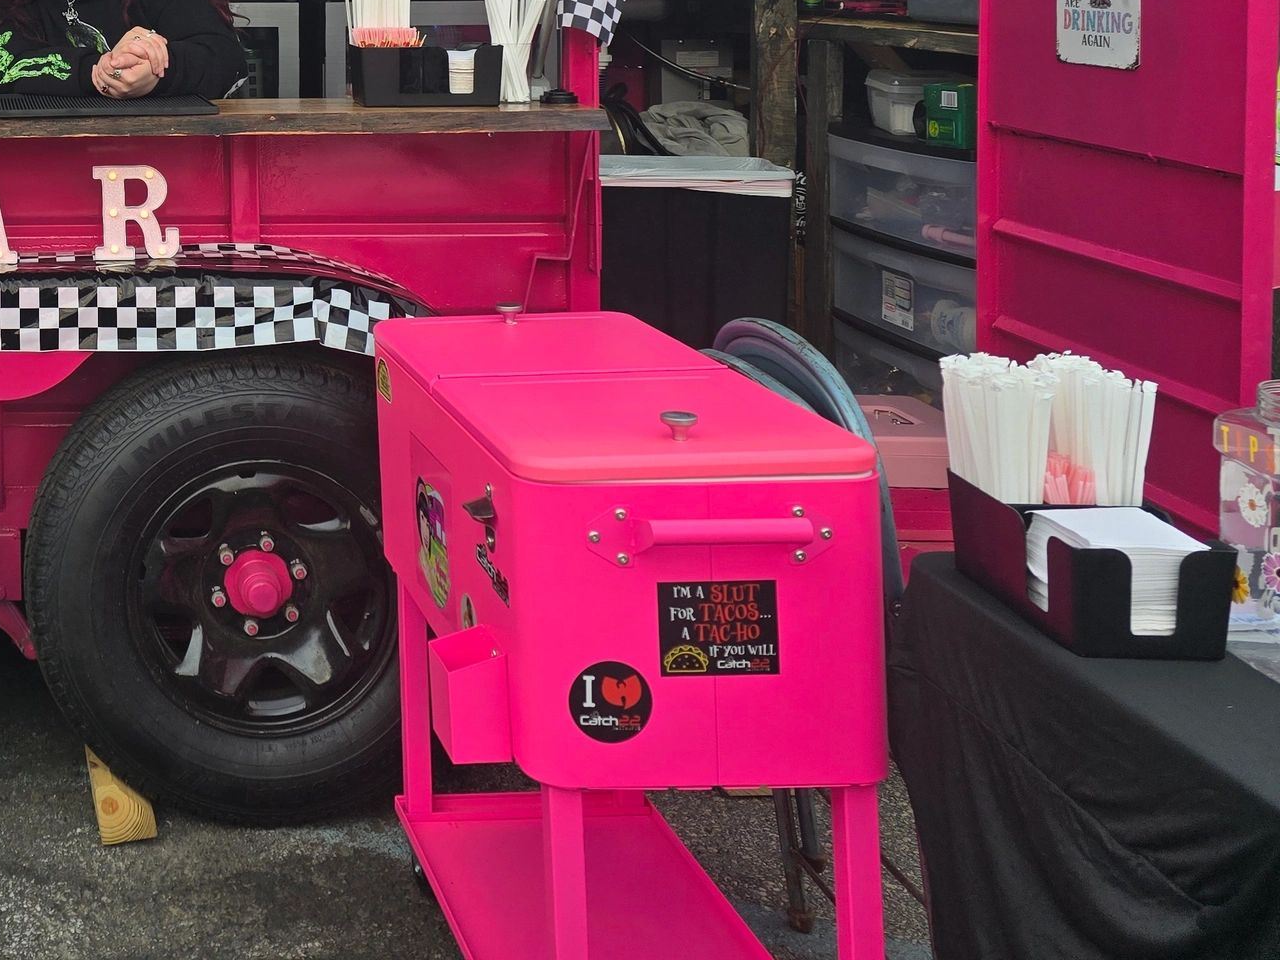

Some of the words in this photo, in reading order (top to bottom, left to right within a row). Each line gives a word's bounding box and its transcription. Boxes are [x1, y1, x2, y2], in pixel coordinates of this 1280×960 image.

[1064, 8, 1133, 35] DRINKING
[1081, 34, 1111, 49] AGAIN
[673, 585, 691, 599] I'M
[696, 585, 705, 599] A
[710, 583, 760, 604] SLUT
[669, 606, 696, 622] FOR
[681, 627, 691, 640] A
[695, 624, 761, 644] TAC-HO
[709, 645, 721, 657] IF
[723, 644, 745, 658] YOU
[747, 644, 777, 656] WILL
[582, 675, 596, 708] I
